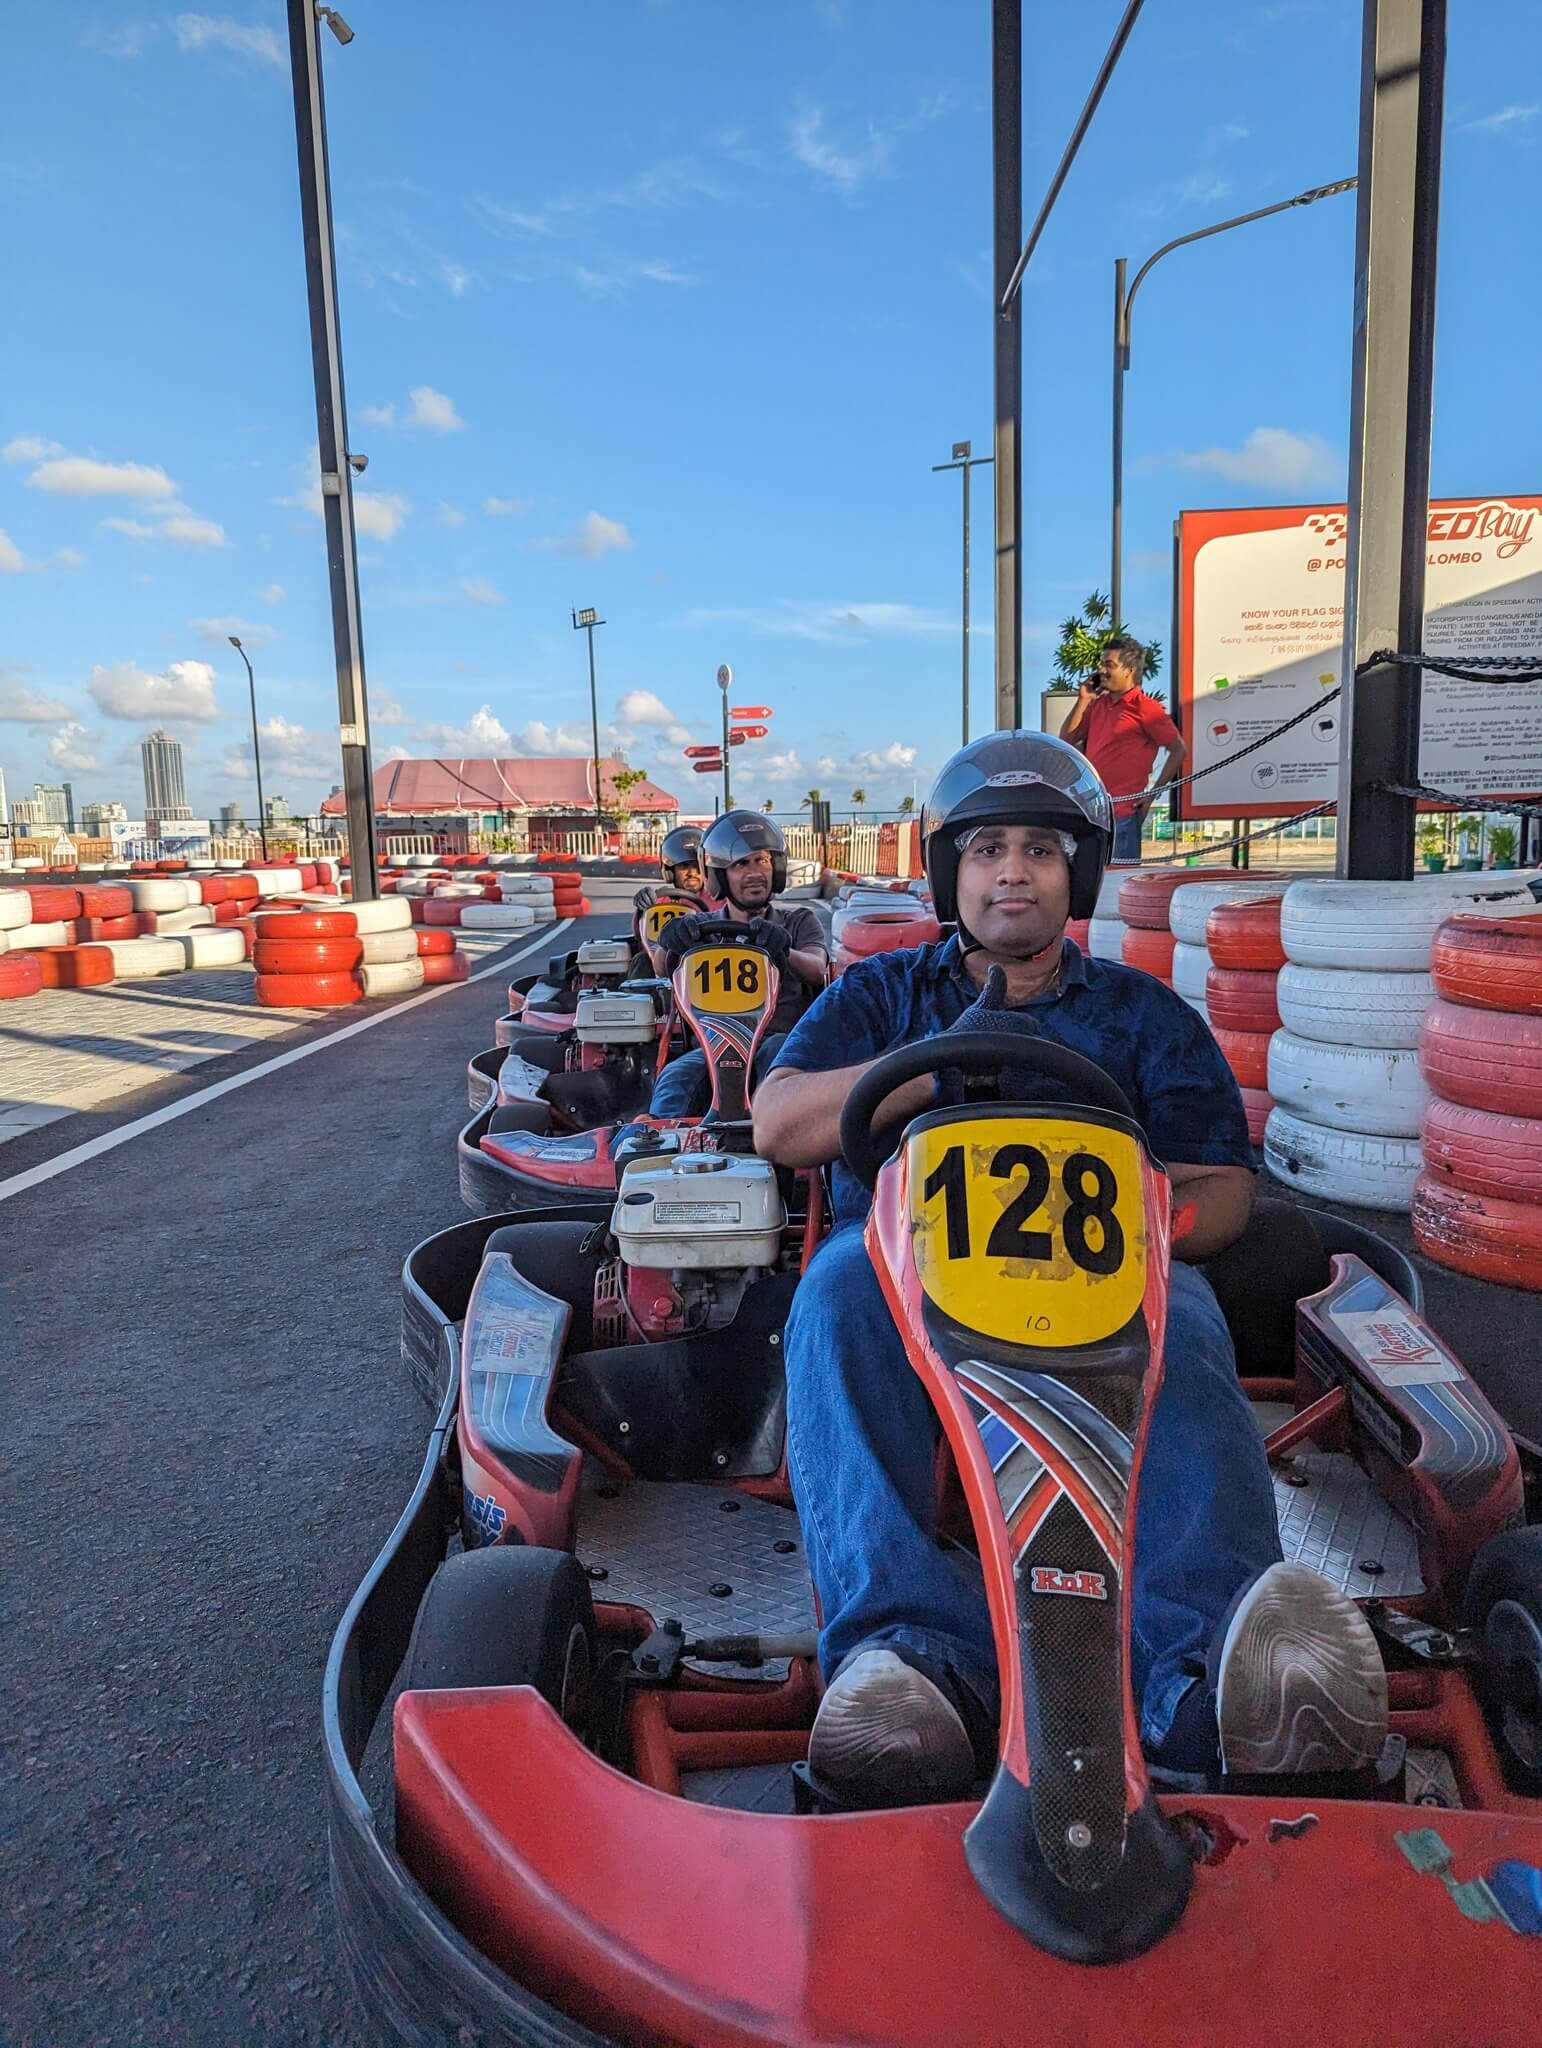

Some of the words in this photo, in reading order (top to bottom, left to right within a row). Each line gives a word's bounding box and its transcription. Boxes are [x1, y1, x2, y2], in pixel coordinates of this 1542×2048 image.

[1428, 512, 1479, 541] ED
[1476, 505, 1536, 559] Bay
[1307, 559, 1321, 572] @
[1325, 558, 1346, 570] PO
[1426, 552, 1482, 566] LOMBO
[1241, 610, 1269, 619] KNOW
[1273, 609, 1299, 618] YOUR
[1301, 608, 1326, 617] FLAG
[1329, 607, 1344, 615] SIG
[650, 911, 685, 932] 12
[694, 958, 758, 993] 118
[924, 1144, 1124, 1275] 128
[1026, 1316, 1050, 1331] 10
[1387, 1323, 1421, 1349] CIRCUIT
